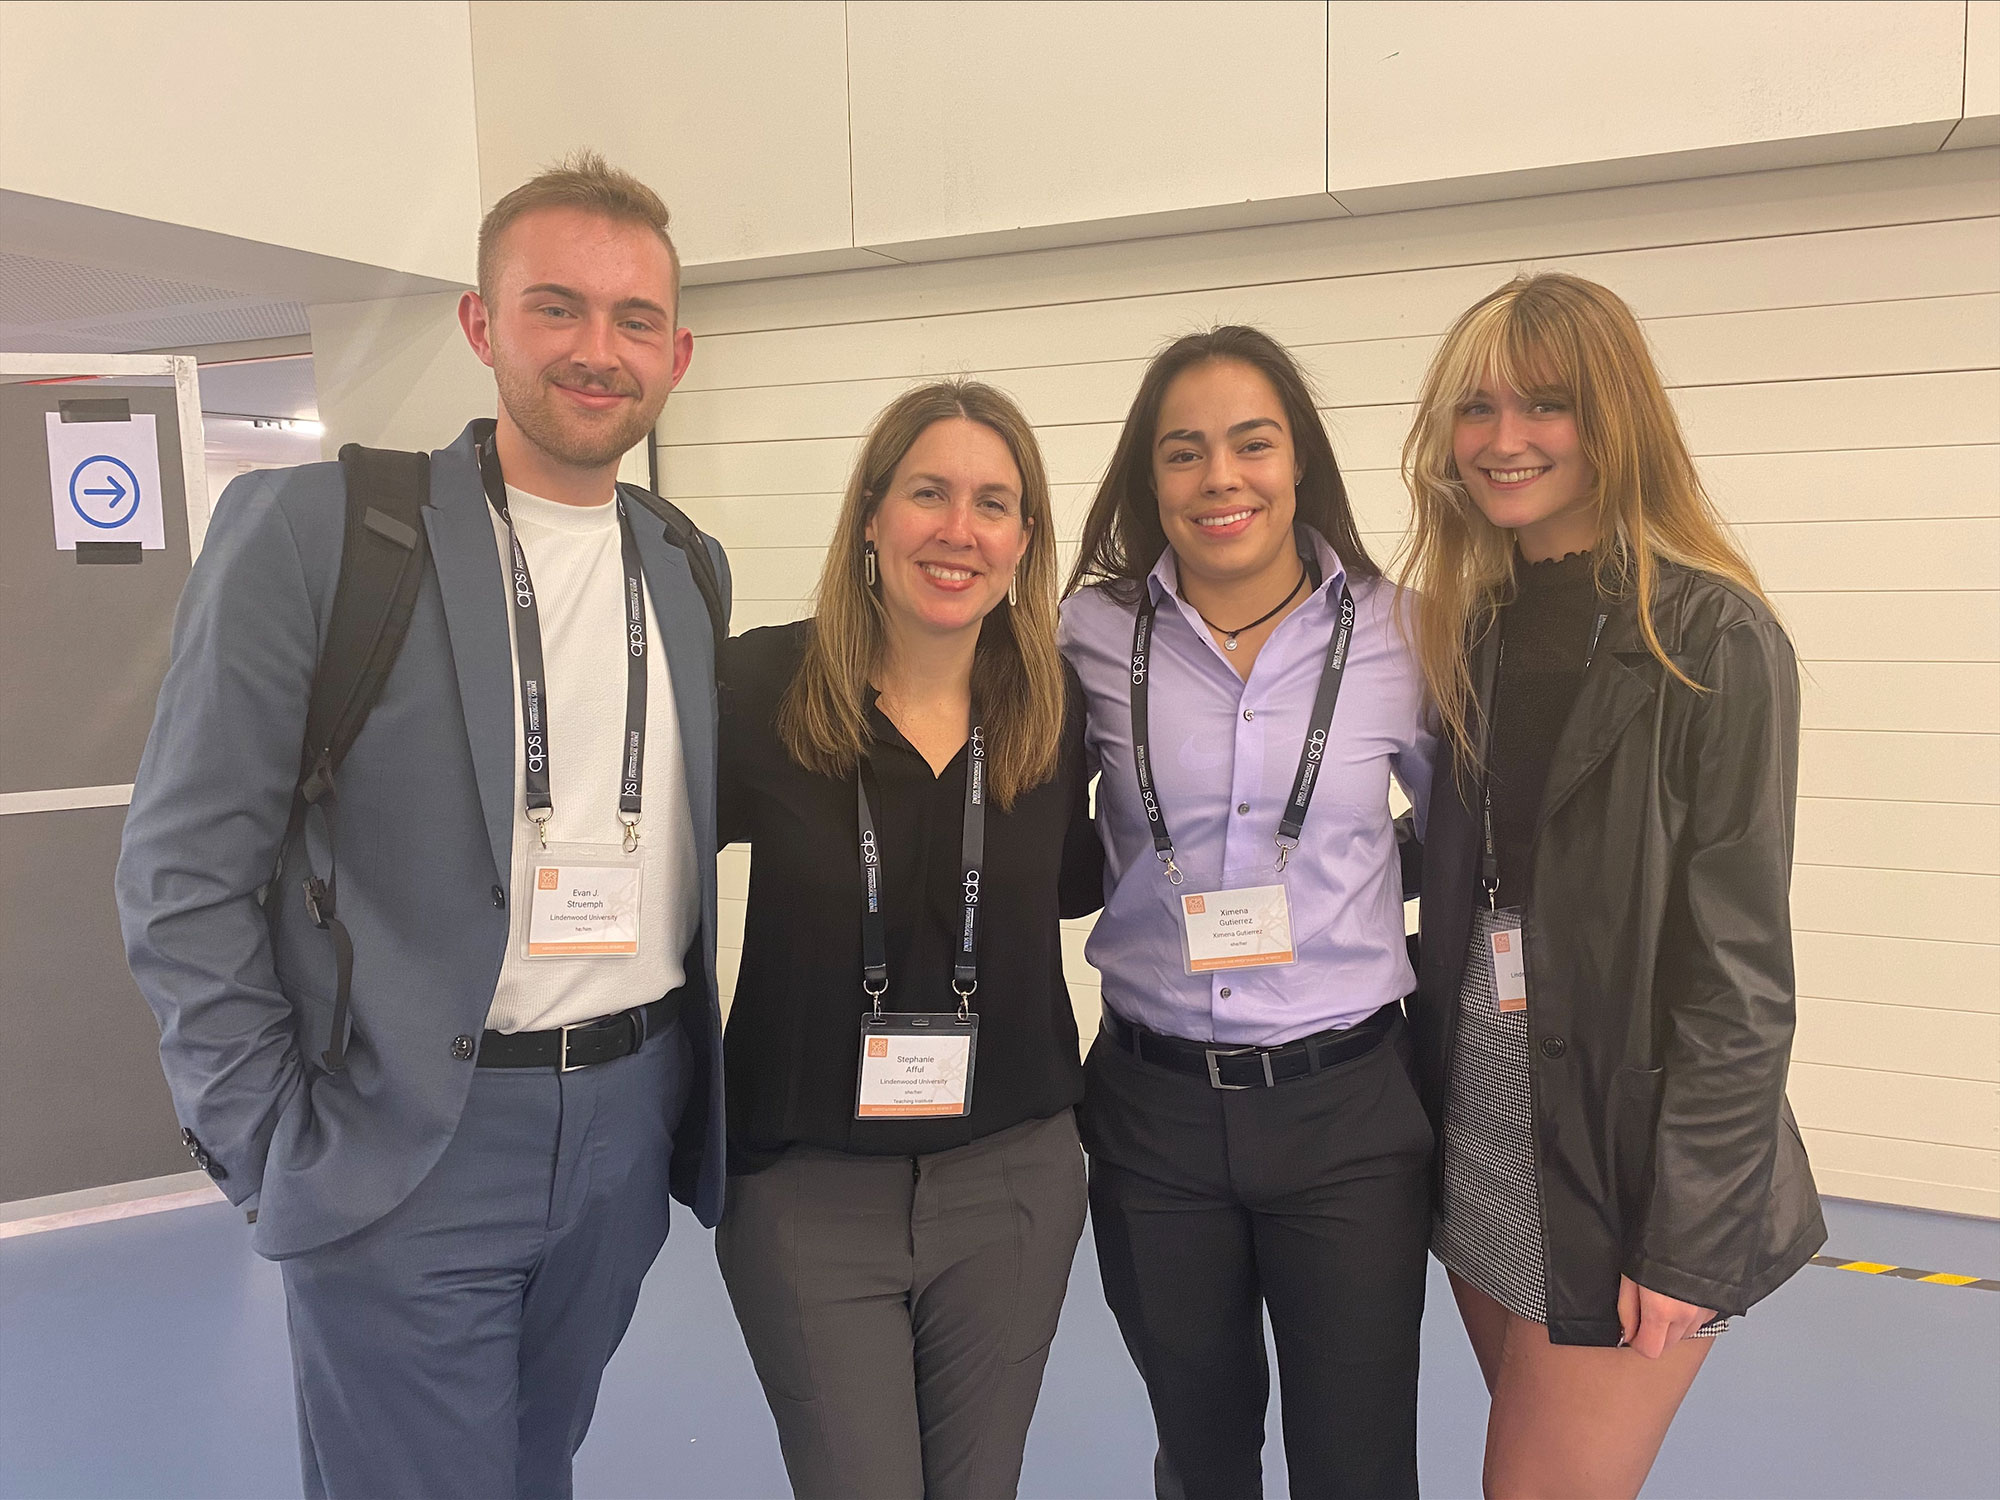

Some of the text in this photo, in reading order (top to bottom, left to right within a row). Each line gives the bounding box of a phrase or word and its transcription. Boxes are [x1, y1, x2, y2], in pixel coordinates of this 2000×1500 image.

[514, 573, 533, 608] aps
[1340, 598, 1354, 626] aps
[630, 624, 646, 657] aps
[1132, 655, 1146, 685] aps
[528, 735, 546, 772] aps
[970, 726, 985, 757] aps
[1307, 729, 1326, 761] aps
[1142, 791, 1159, 822] aps
[860, 830, 877, 863] aps
[573, 889, 599, 897] Evan J.
[963, 870, 980, 903] aps
[567, 900, 604, 909] Struemph
[588, 914, 618, 922] University
[1220, 907, 1249, 917] Ximena
[1219, 917, 1253, 927] Gutierrez
[1236, 928, 1263, 937] Gutierrez
[896, 1056, 935, 1064] Stephanie
[918, 1078, 948, 1086] University
